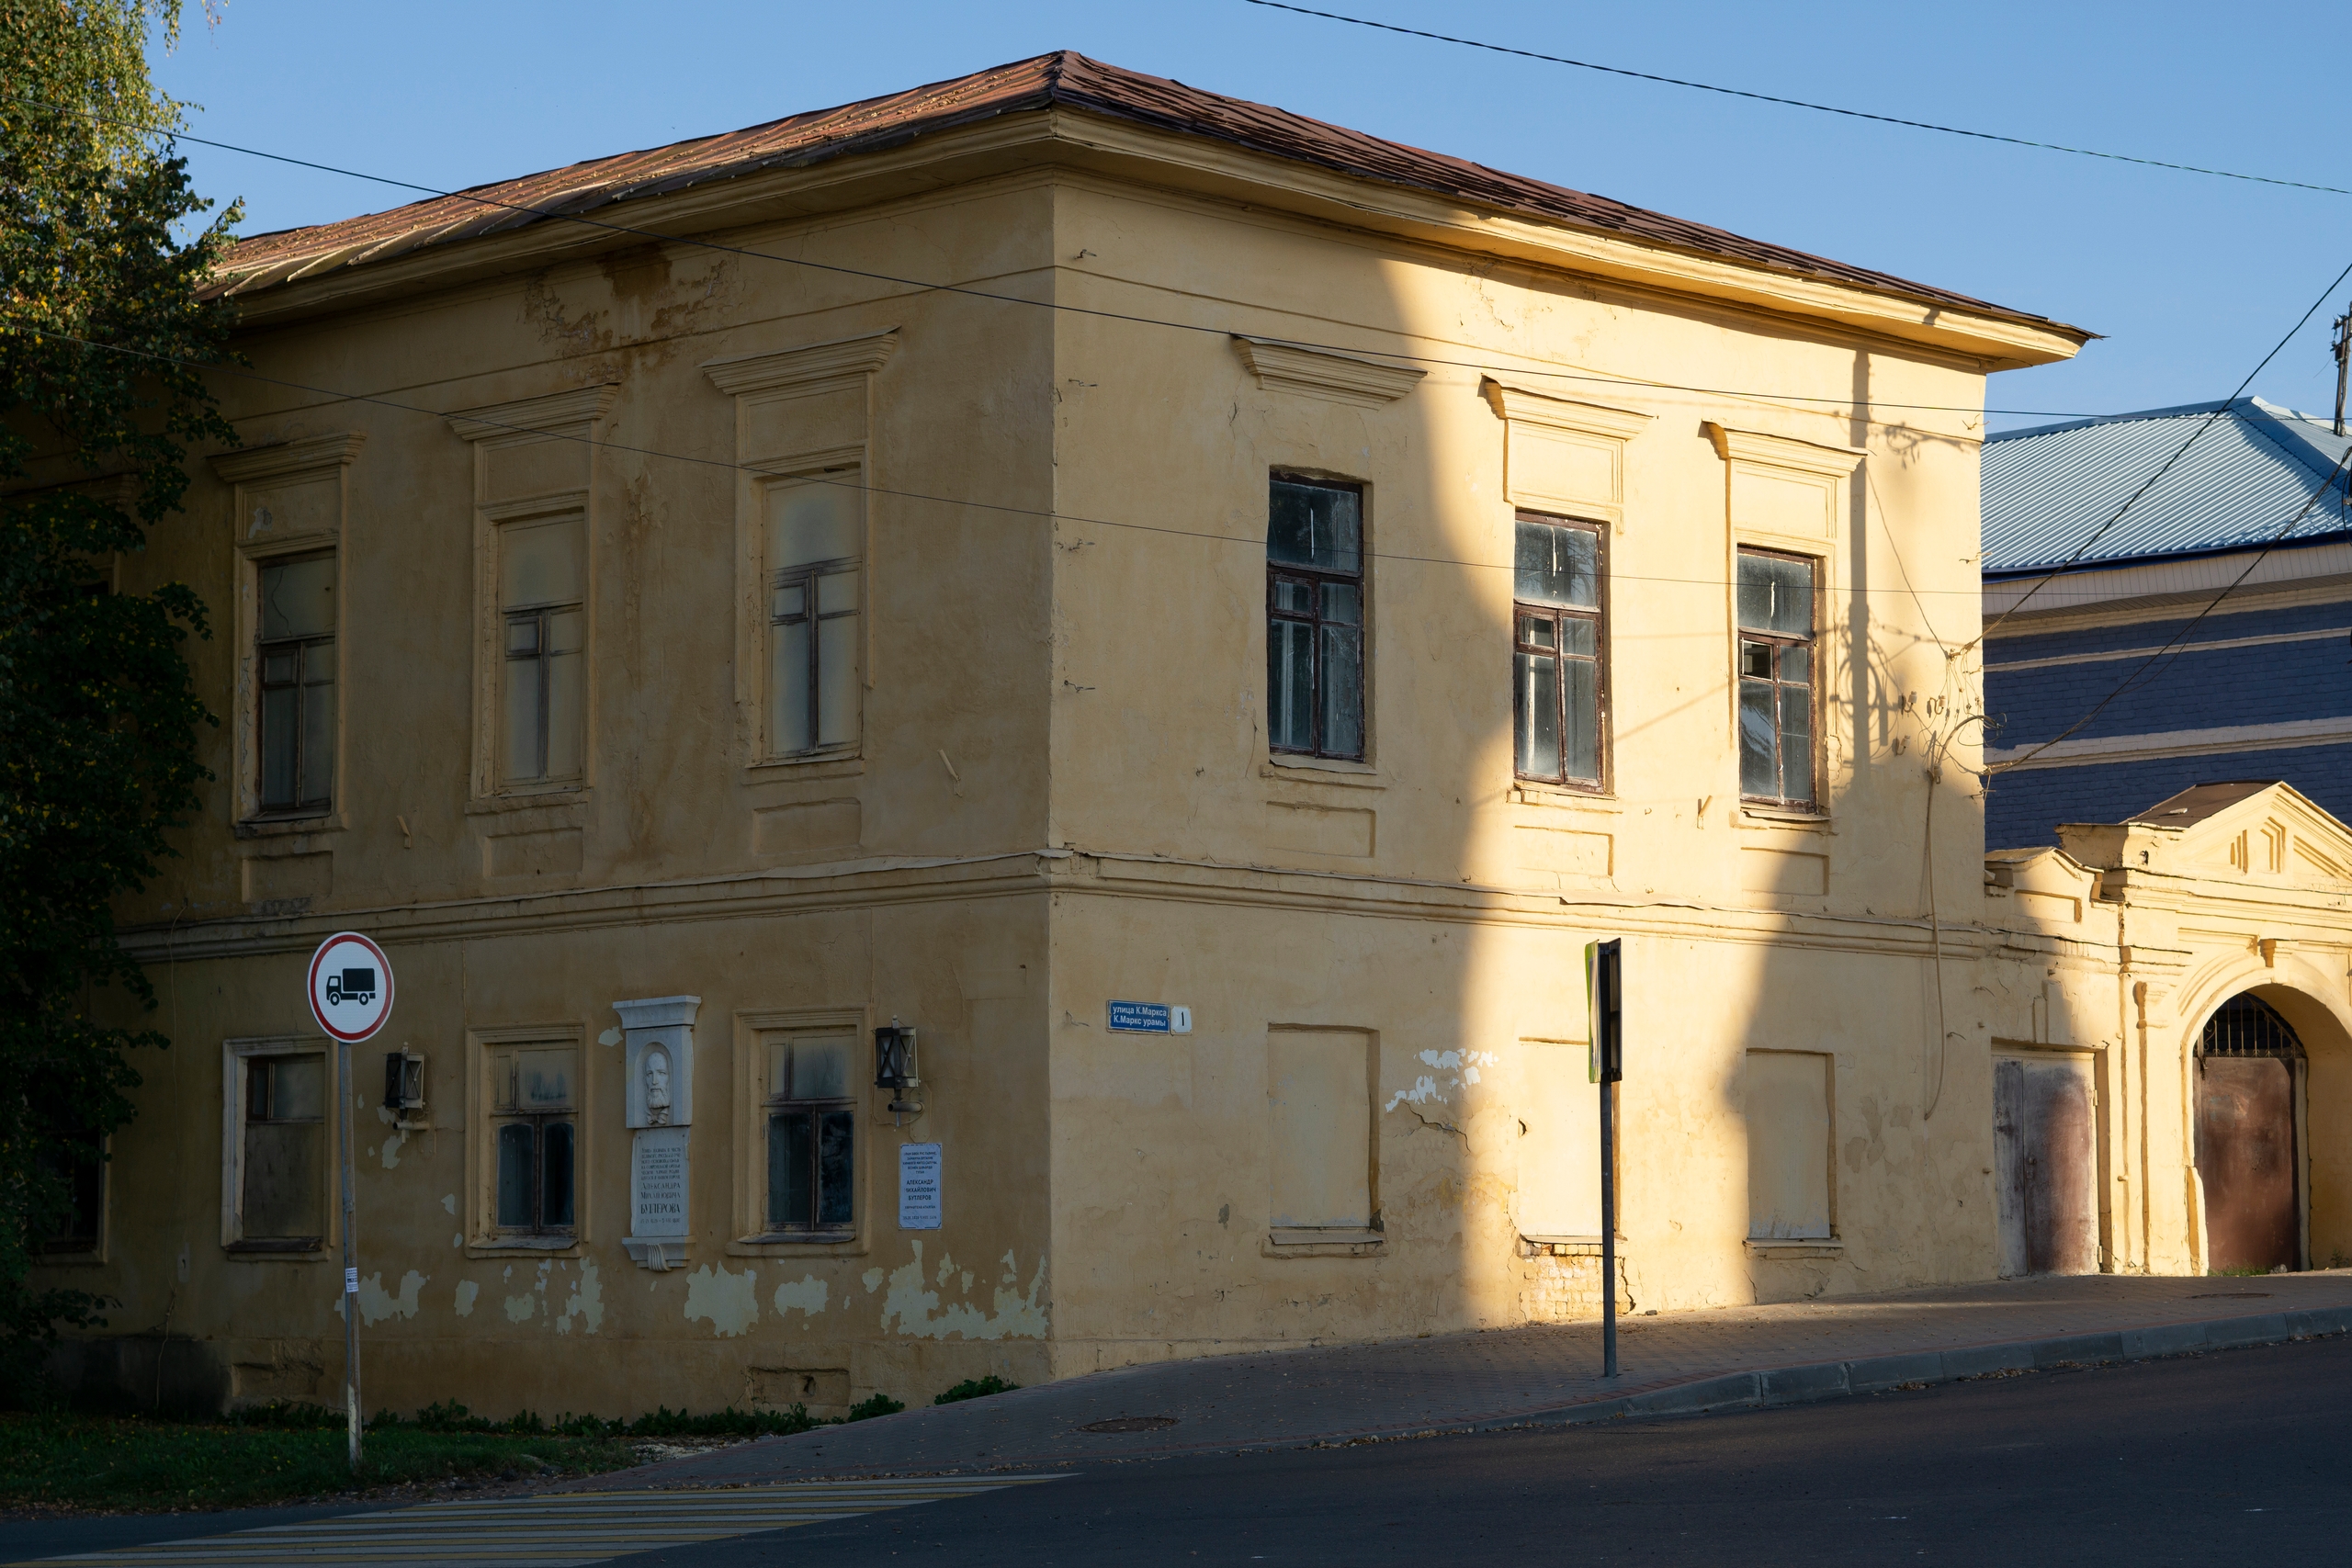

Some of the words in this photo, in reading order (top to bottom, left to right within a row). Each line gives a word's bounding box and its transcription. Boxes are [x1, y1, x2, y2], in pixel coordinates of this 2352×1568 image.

[1113, 1006, 1135, 1015] улица
[1136, 1006, 1167, 1017] К.Маркса
[1114, 1014, 1142, 1026] К.Маркс
[1143, 1018, 1166, 1027] урамы
[1181, 1011, 1185, 1026] 1
